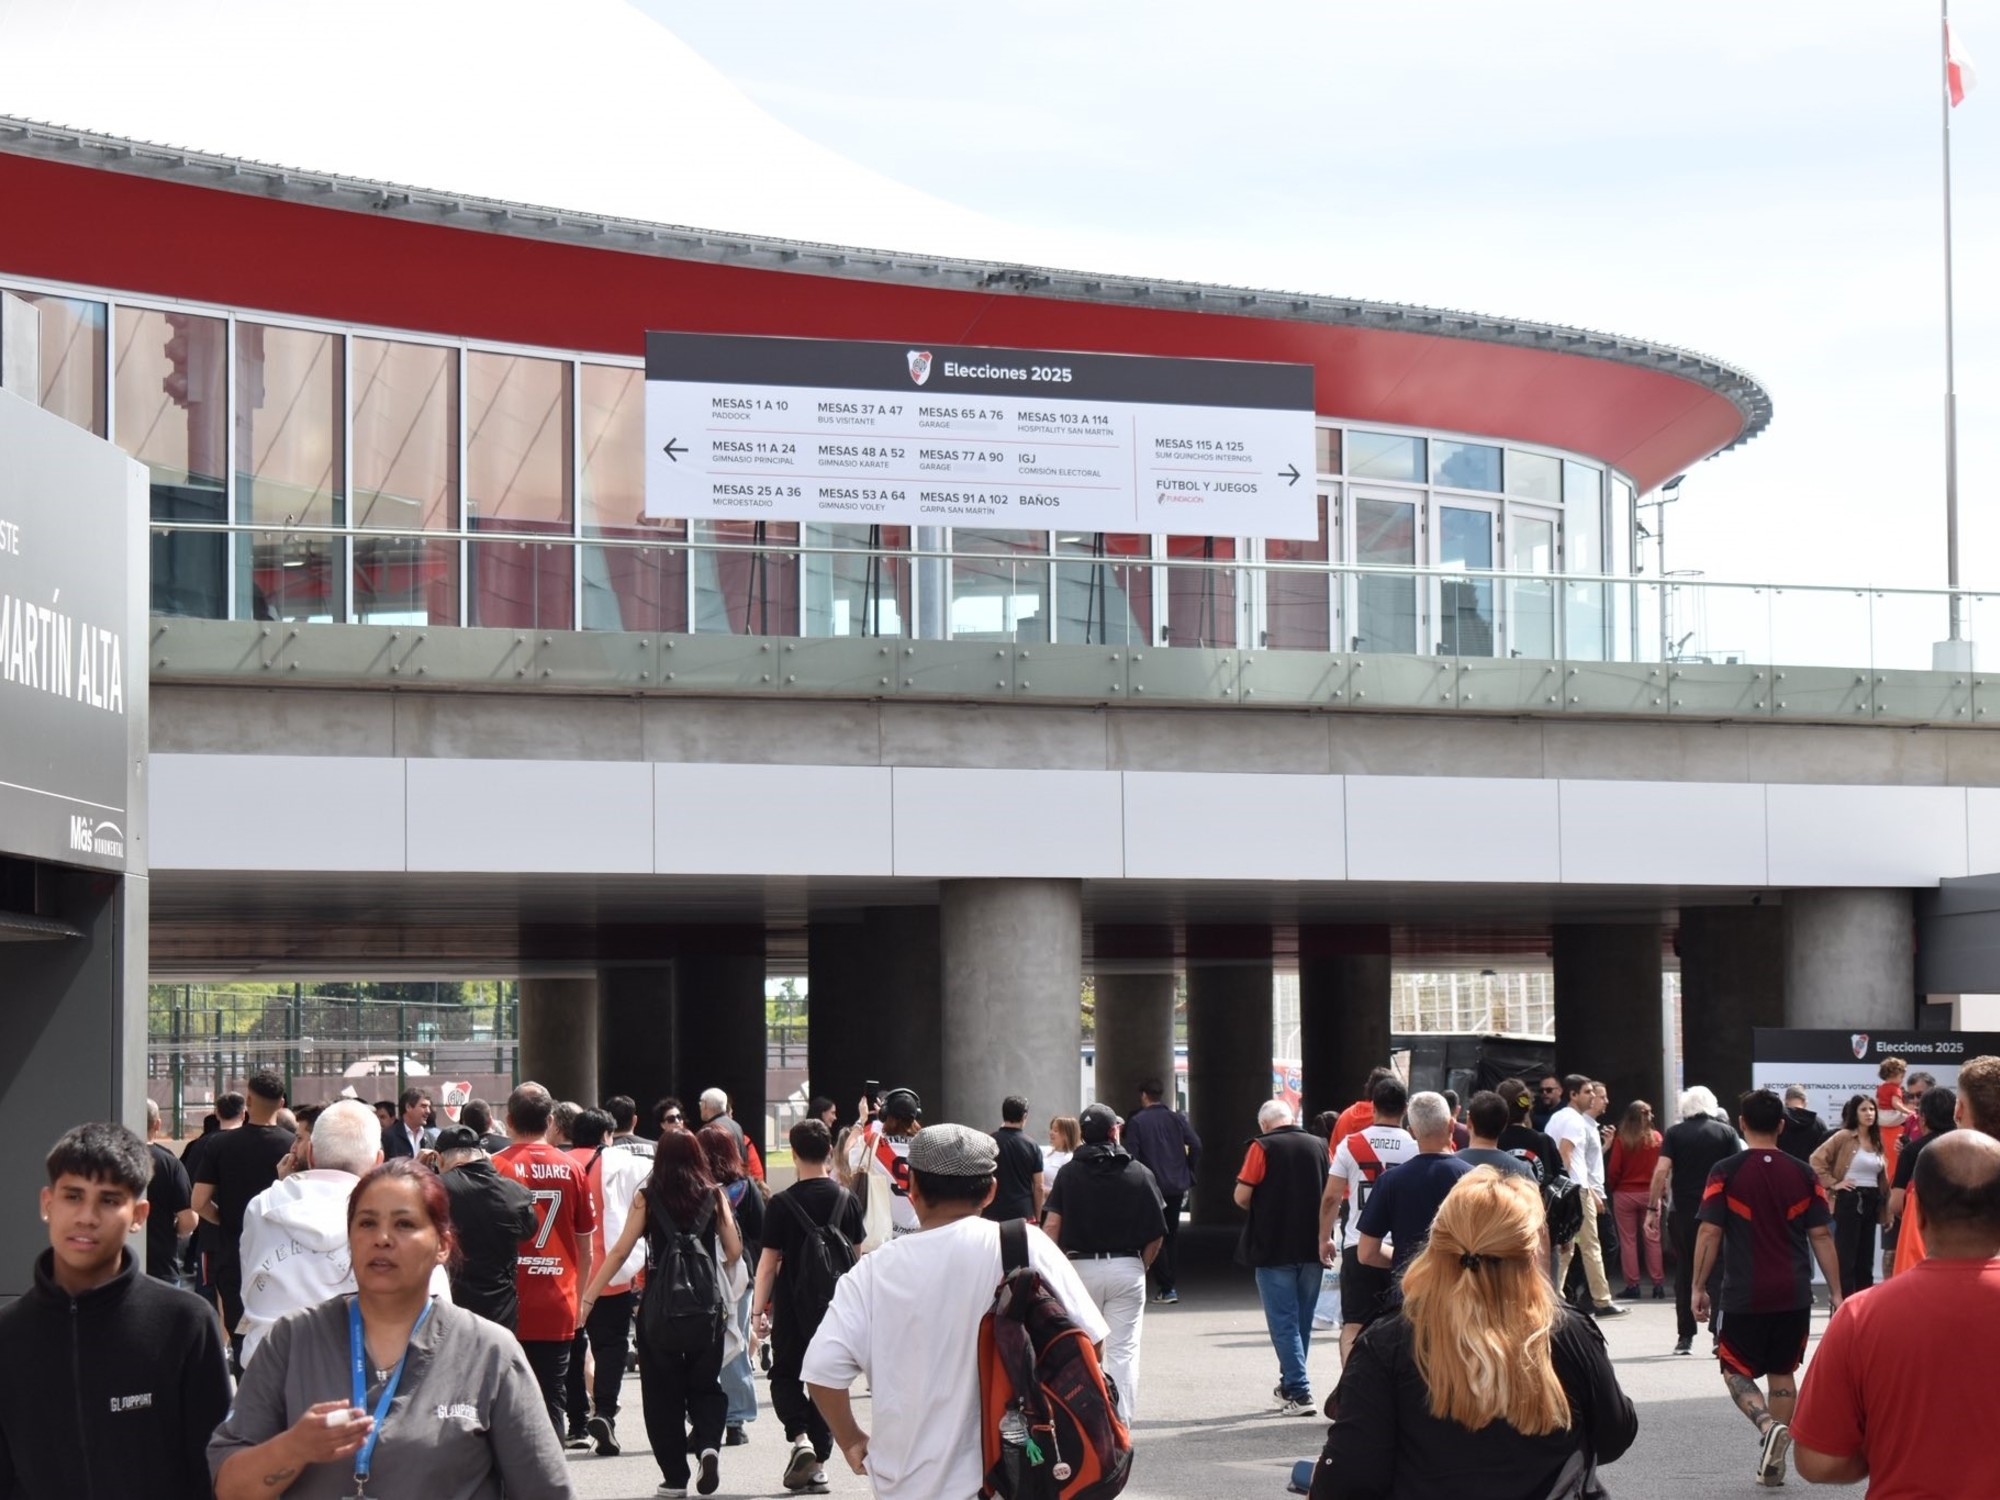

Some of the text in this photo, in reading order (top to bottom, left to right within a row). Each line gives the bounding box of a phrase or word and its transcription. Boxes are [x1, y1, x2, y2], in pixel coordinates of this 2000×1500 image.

[944, 362, 1027, 381] Elecciones
[1031, 367, 1072, 383] 2025
[712, 398, 752, 410] MESAS
[764, 400, 772, 411] A
[776, 401, 788, 411] 10
[818, 403, 903, 416] MESAS 37 A 47
[712, 412, 751, 421] PADDOCK
[919, 407, 1003, 421] MESAS 65 A 76
[1018, 412, 1108, 426] MESAS 103 A 114
[818, 416, 875, 426] BUS VISITANTE
[919, 420, 950, 429] GARAGE
[1018, 425, 1065, 434] HOSPITALITY
[1068, 427, 1083, 435] SAN
[713, 441, 796, 454] MESAS 11 A 24
[819, 445, 904, 459] MESAS 48 A 52
[1156, 439, 1244, 452] MESAS 115 A 125
[712, 455, 794, 466] GIMNASIO PRINCIPAL
[920, 450, 1003, 463] MESAS 77 A 90
[1019, 454, 1035, 464] IGJ
[1155, 452, 1252, 463] SUM QUINCHOS INTERNOS
[818, 459, 889, 469] GIMNASIO KARATE
[920, 463, 951, 472] GARAGE
[1059, 469, 1101, 478] ELECTORAL
[713, 484, 801, 498] MESAS 25 A 36
[1157, 477, 1257, 494] FÚTBOL Y JUEGOS
[819, 488, 905, 501] MESAS 53 A 64
[921, 492, 1008, 505] MESAS 91 A 102
[1020, 494, 1060, 508] BAÑOS
[713, 498, 773, 508] MICROESTADIO
[819, 502, 885, 512] GIMNASIO VOLEY
[920, 506, 946, 514] CARPA
[948, 506, 963, 514] SAN
[0, 588, 123, 714] MARTÍN ALTA
[1876, 1041, 1965, 1053] Elecciones 2025
[514, 1163, 572, 1180] M. SUAREZ
[530, 1190, 562, 1249] 7
